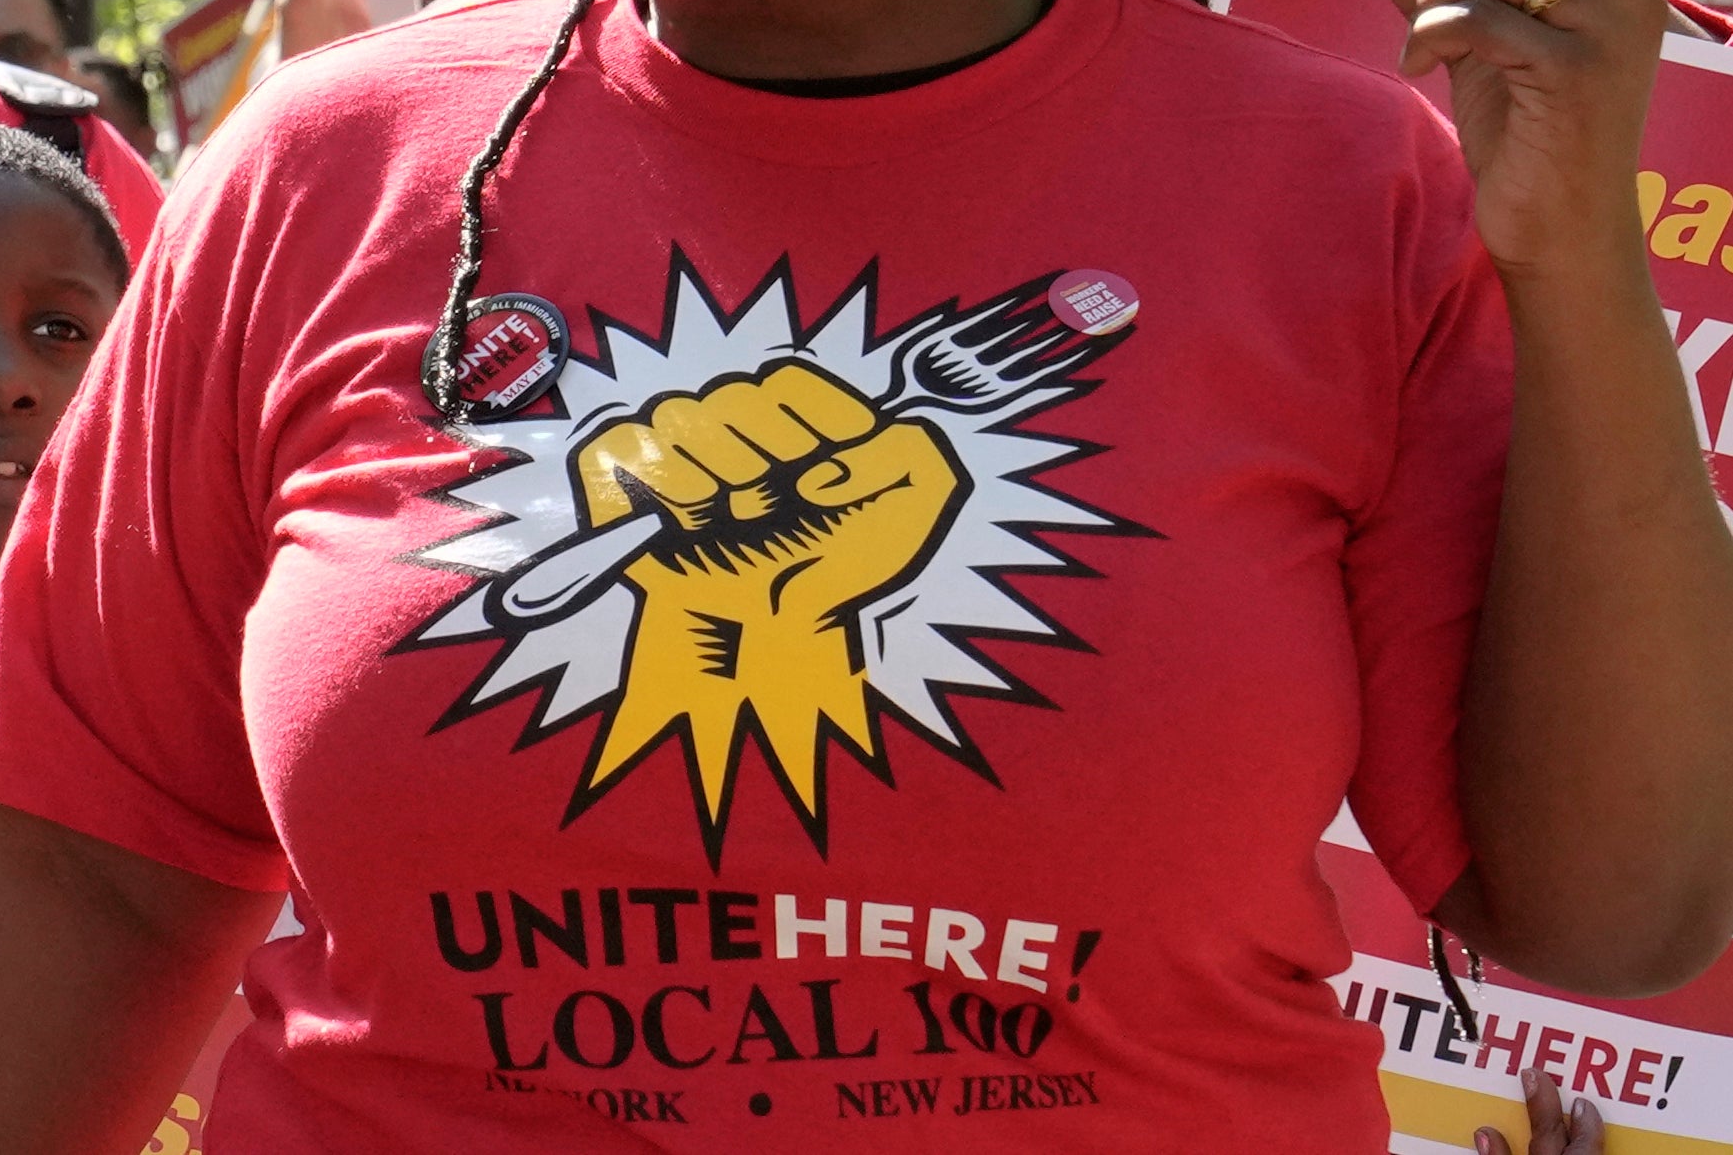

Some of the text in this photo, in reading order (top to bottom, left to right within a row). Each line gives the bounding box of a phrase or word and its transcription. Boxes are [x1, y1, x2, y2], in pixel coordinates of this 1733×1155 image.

[490, 301, 511, 312] ALL
[513, 301, 561, 340] IMMIGRANTS
[1072, 293, 1105, 314] NEED
[1102, 289, 1115, 300] A
[1081, 297, 1126, 324] RAISE
[502, 376, 531, 401] MAY
[429, 887, 1102, 1003] UNITEHERE!
[472, 979, 1054, 1074] LOCAL 100
[572, 1088, 689, 1124] ORK
[836, 1077, 943, 1121] NEW
[953, 1070, 1103, 1117] JERSEY
